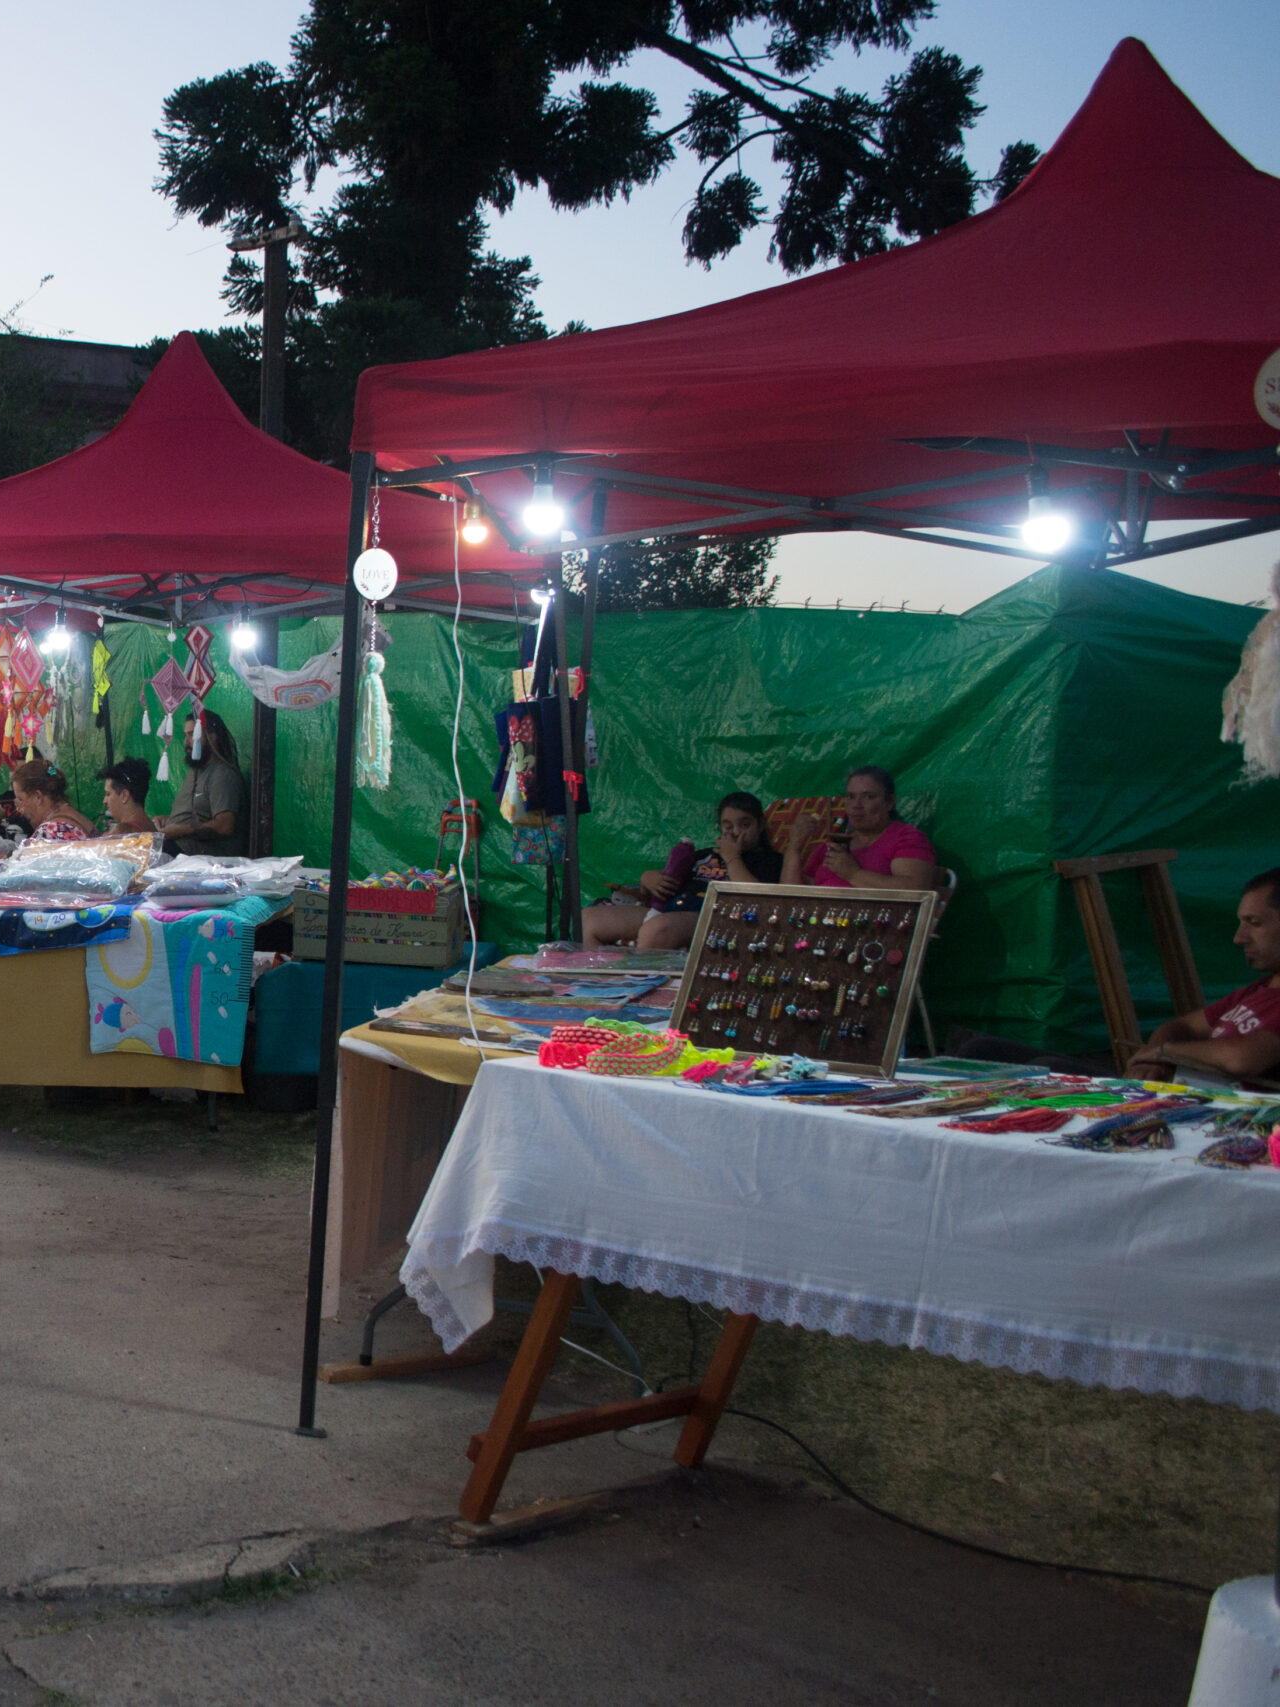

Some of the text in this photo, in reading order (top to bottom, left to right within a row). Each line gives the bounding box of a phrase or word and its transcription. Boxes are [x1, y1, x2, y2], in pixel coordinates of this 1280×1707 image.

[361, 567, 390, 581] LOVE
[52, 912, 66, 924] 20
[209, 990, 229, 1006] 50
